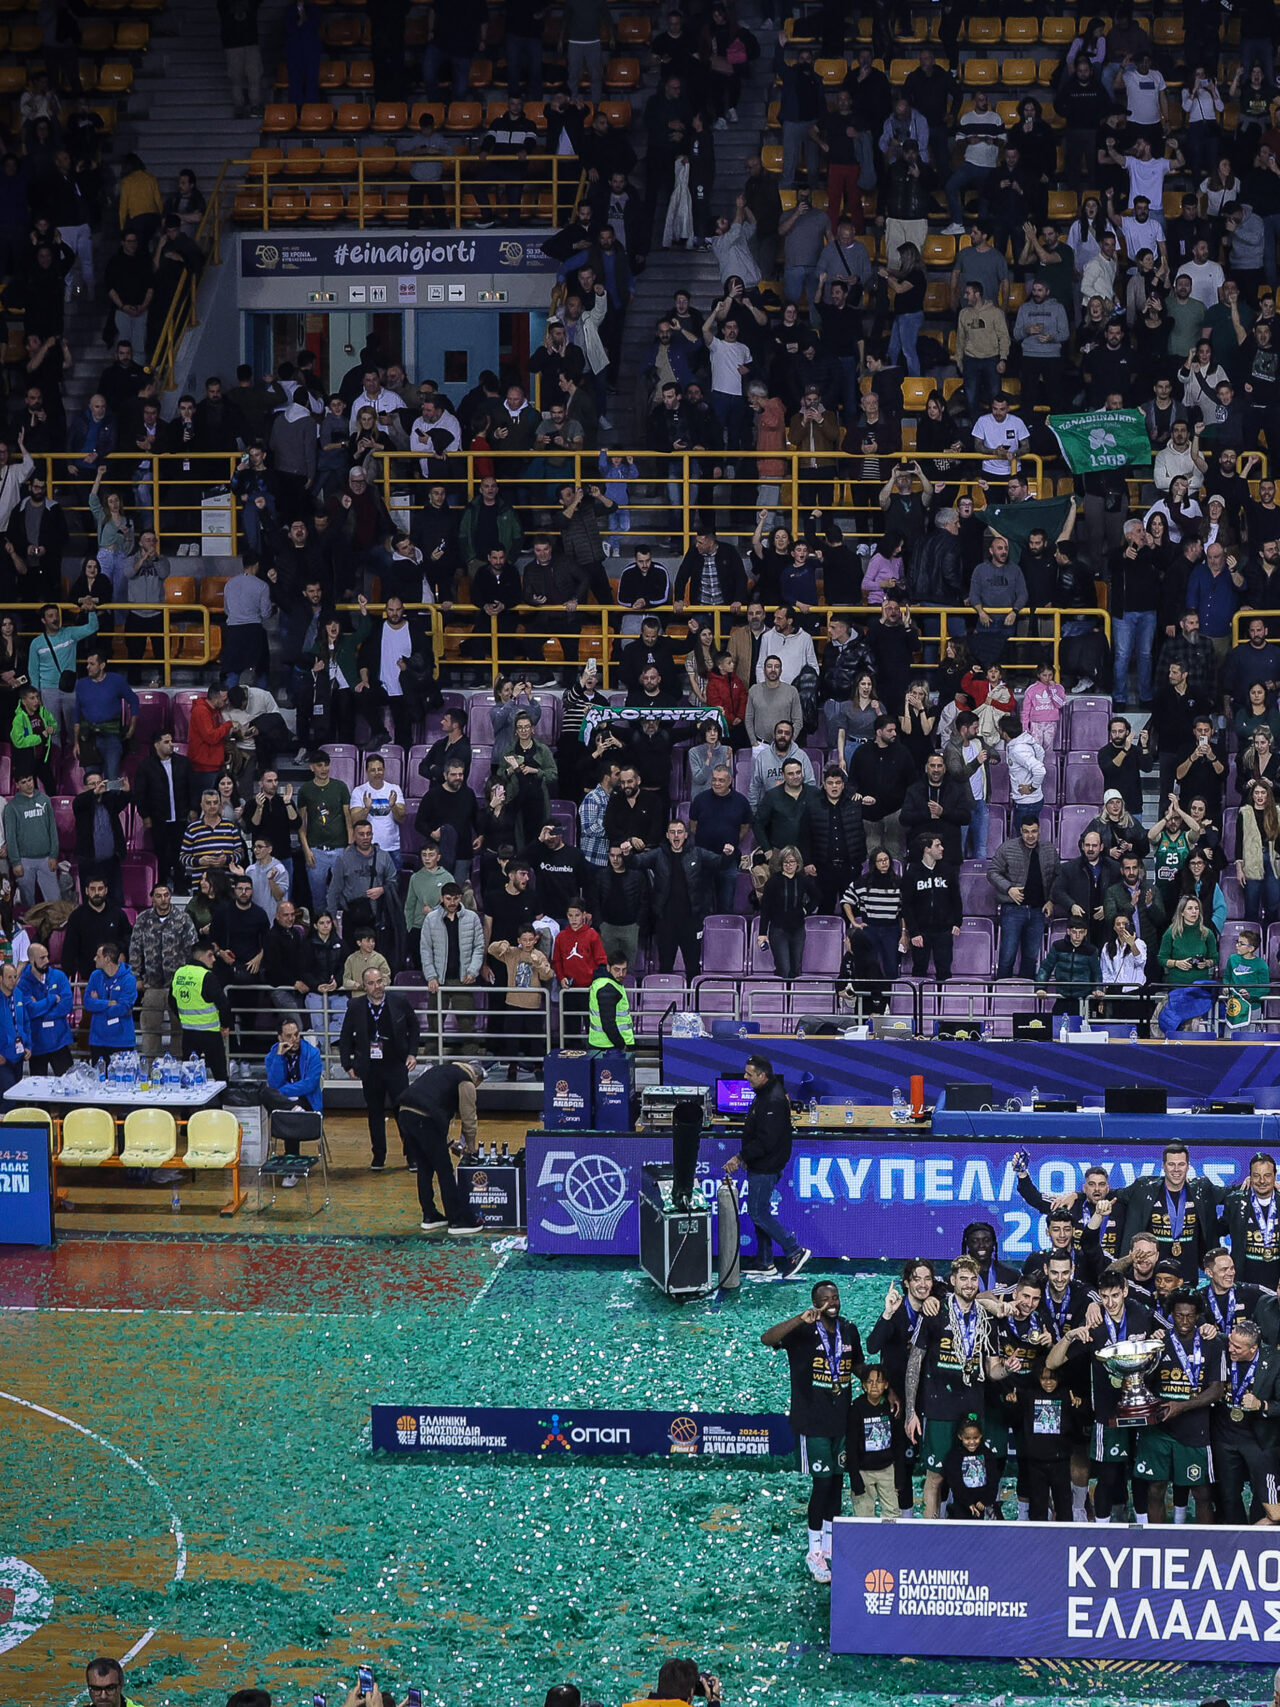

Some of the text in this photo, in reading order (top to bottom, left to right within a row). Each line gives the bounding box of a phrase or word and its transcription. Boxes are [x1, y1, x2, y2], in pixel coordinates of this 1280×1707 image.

[334, 240, 476, 270] #einaigiorti
[1166, 853, 1179, 865] 25
[545, 863, 573, 873] Columbia
[419, 1415, 467, 1426] ΕΛΛΗΝΙΚΗ
[420, 1426, 481, 1437] ΟΜΟΣΠΟΝΔΙΑ
[419, 1436, 507, 1447] ΚΑΛΑΘΟΣΦΑΙΡΙΣΗΣ
[703, 1442, 769, 1454] ΑΝΔΡΩΝ
[899, 1569, 968, 1585] ΕΛΛΗΝΙΚΗ
[899, 1585, 989, 1601] ΟΜΟΣΠΟΝΔΙΑ
[898, 1600, 1028, 1618] ΚΑΛΑΘΟΣΦΑΙΡΙΣΗΣ
